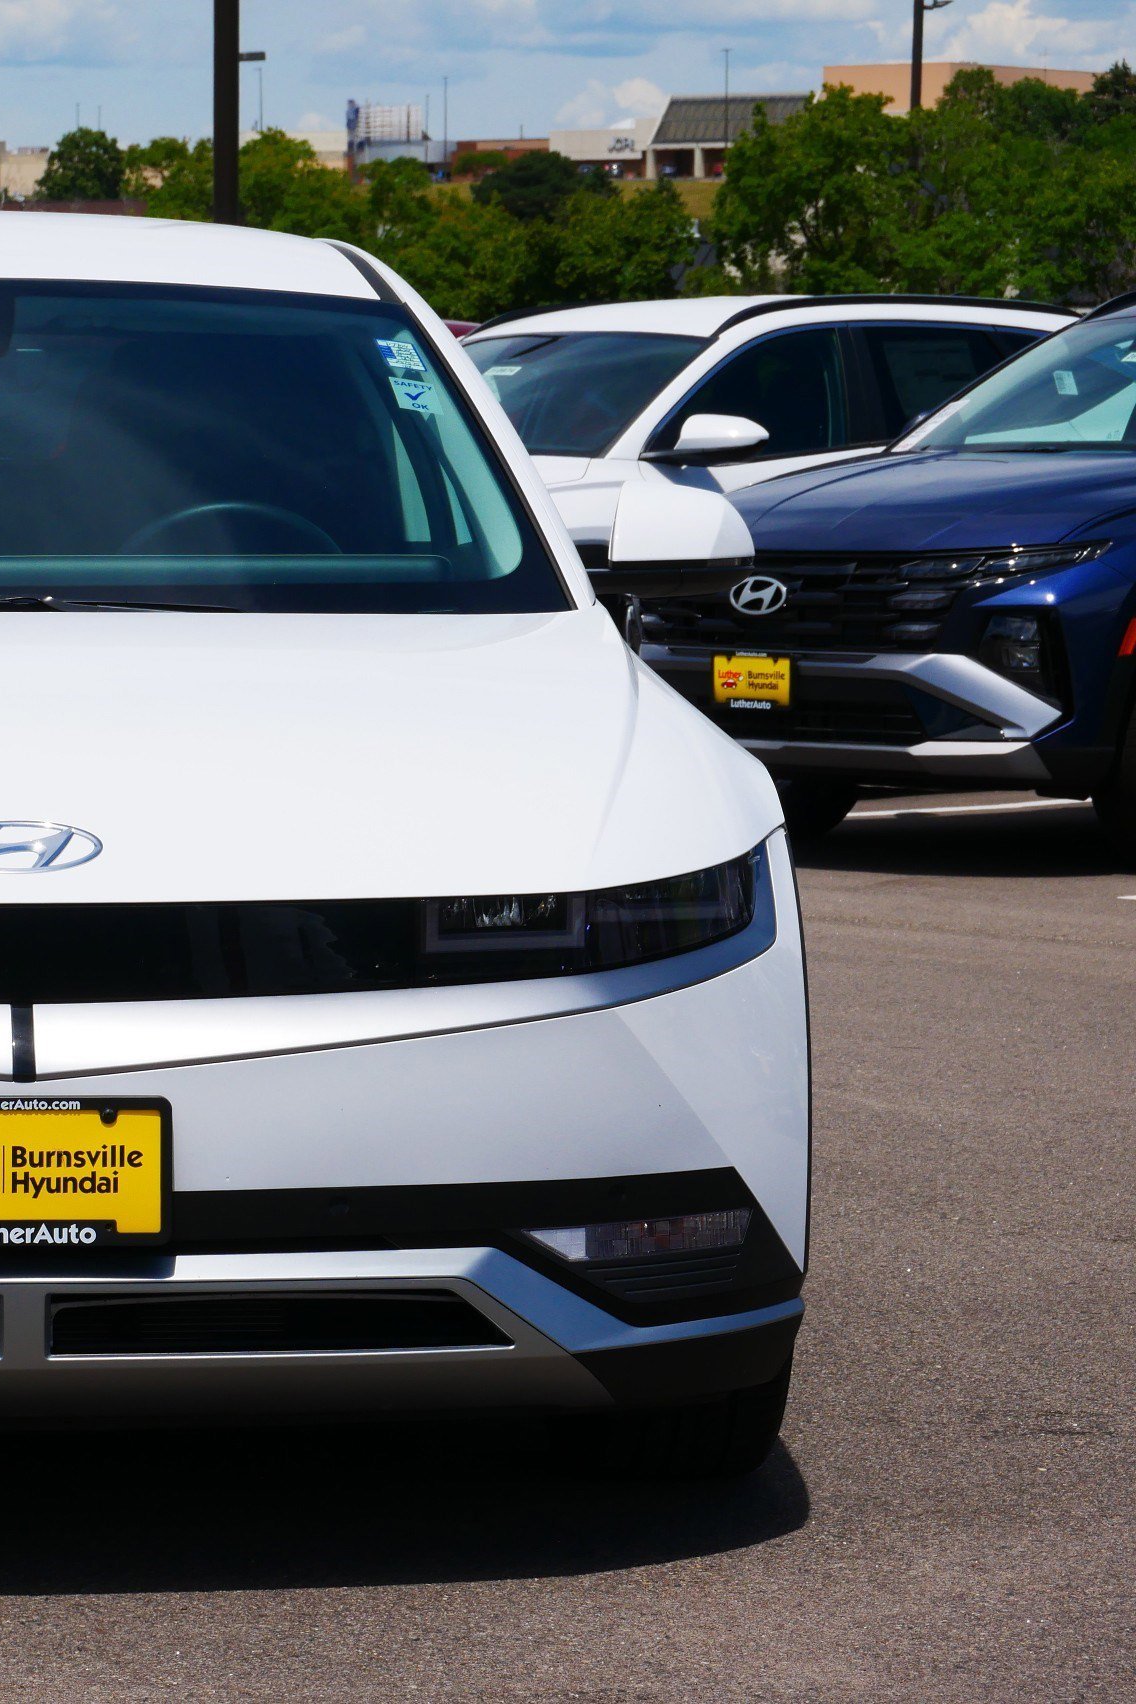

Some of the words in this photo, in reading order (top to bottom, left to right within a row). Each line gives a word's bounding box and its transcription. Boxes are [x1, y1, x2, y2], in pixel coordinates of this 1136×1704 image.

[393, 380, 432, 391] SAFETY
[718, 670, 742, 679] Luther
[747, 671, 785, 680] Burnsville
[748, 681, 779, 691] Hyundai
[730, 699, 772, 710] LutherAuto
[11, 1145, 144, 1168] Burnsville
[11, 1171, 119, 1199] Hyundai
